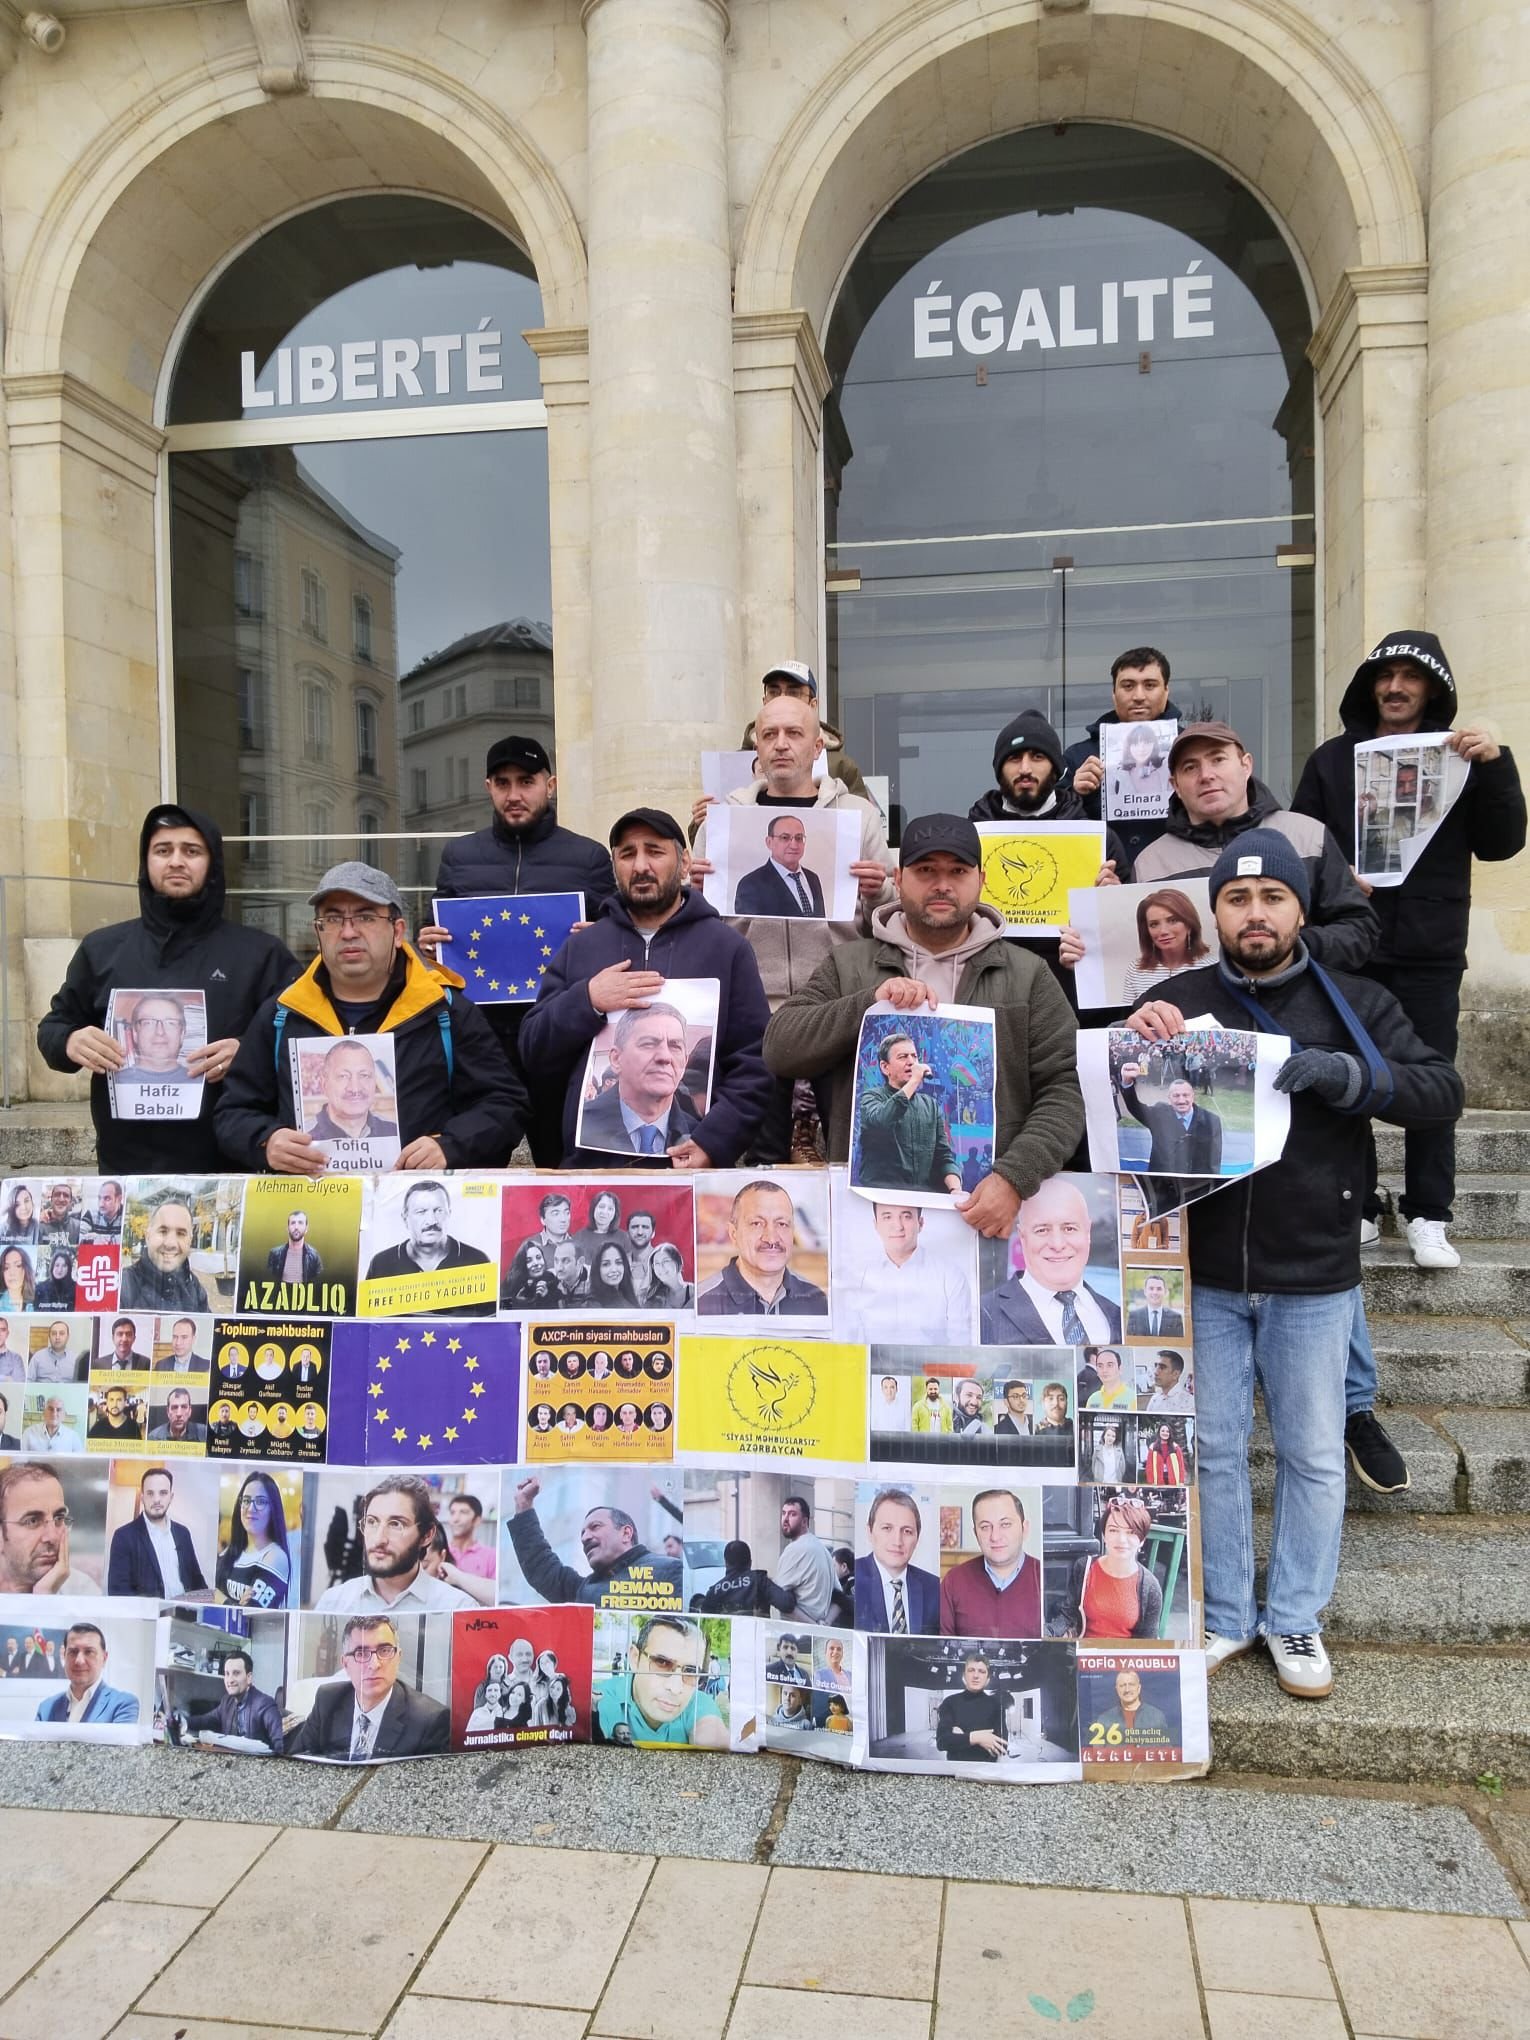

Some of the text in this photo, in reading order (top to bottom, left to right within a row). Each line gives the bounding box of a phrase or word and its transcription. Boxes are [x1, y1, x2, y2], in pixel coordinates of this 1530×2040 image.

[914, 260, 1215, 359] ÉGALITÉ
[241, 316, 503, 408] LIBERTÉ
[1123, 794, 1161, 804] Elnara
[139, 1084, 180, 1097] Hafiz
[134, 1103, 184, 1116] Babalı
[332, 1139, 370, 1154] Tofiq
[256, 1180, 350, 1196] Mehman Əliyevə
[244, 1280, 347, 1315] AZADLIQ
[368, 1281, 487, 1308] FREE TOFIG YAGUBLU
[266, 1324, 325, 1339] məhbusları
[540, 1330, 664, 1343] AXCP-nin siyasi məhbusları
[739, 1443, 804, 1456] AZƏRBAYCAN
[627, 1566, 653, 1580] WE
[609, 1581, 675, 1595] DEMAND
[714, 1576, 751, 1594] POLİS
[601, 1595, 683, 1611] FREEDOOM
[1080, 1656, 1176, 1669] TOFİQ YAQUBLU
[463, 1732, 515, 1746] Jurnalistika
[1088, 1722, 1123, 1745] 26
[1124, 1727, 1140, 1736] gün
